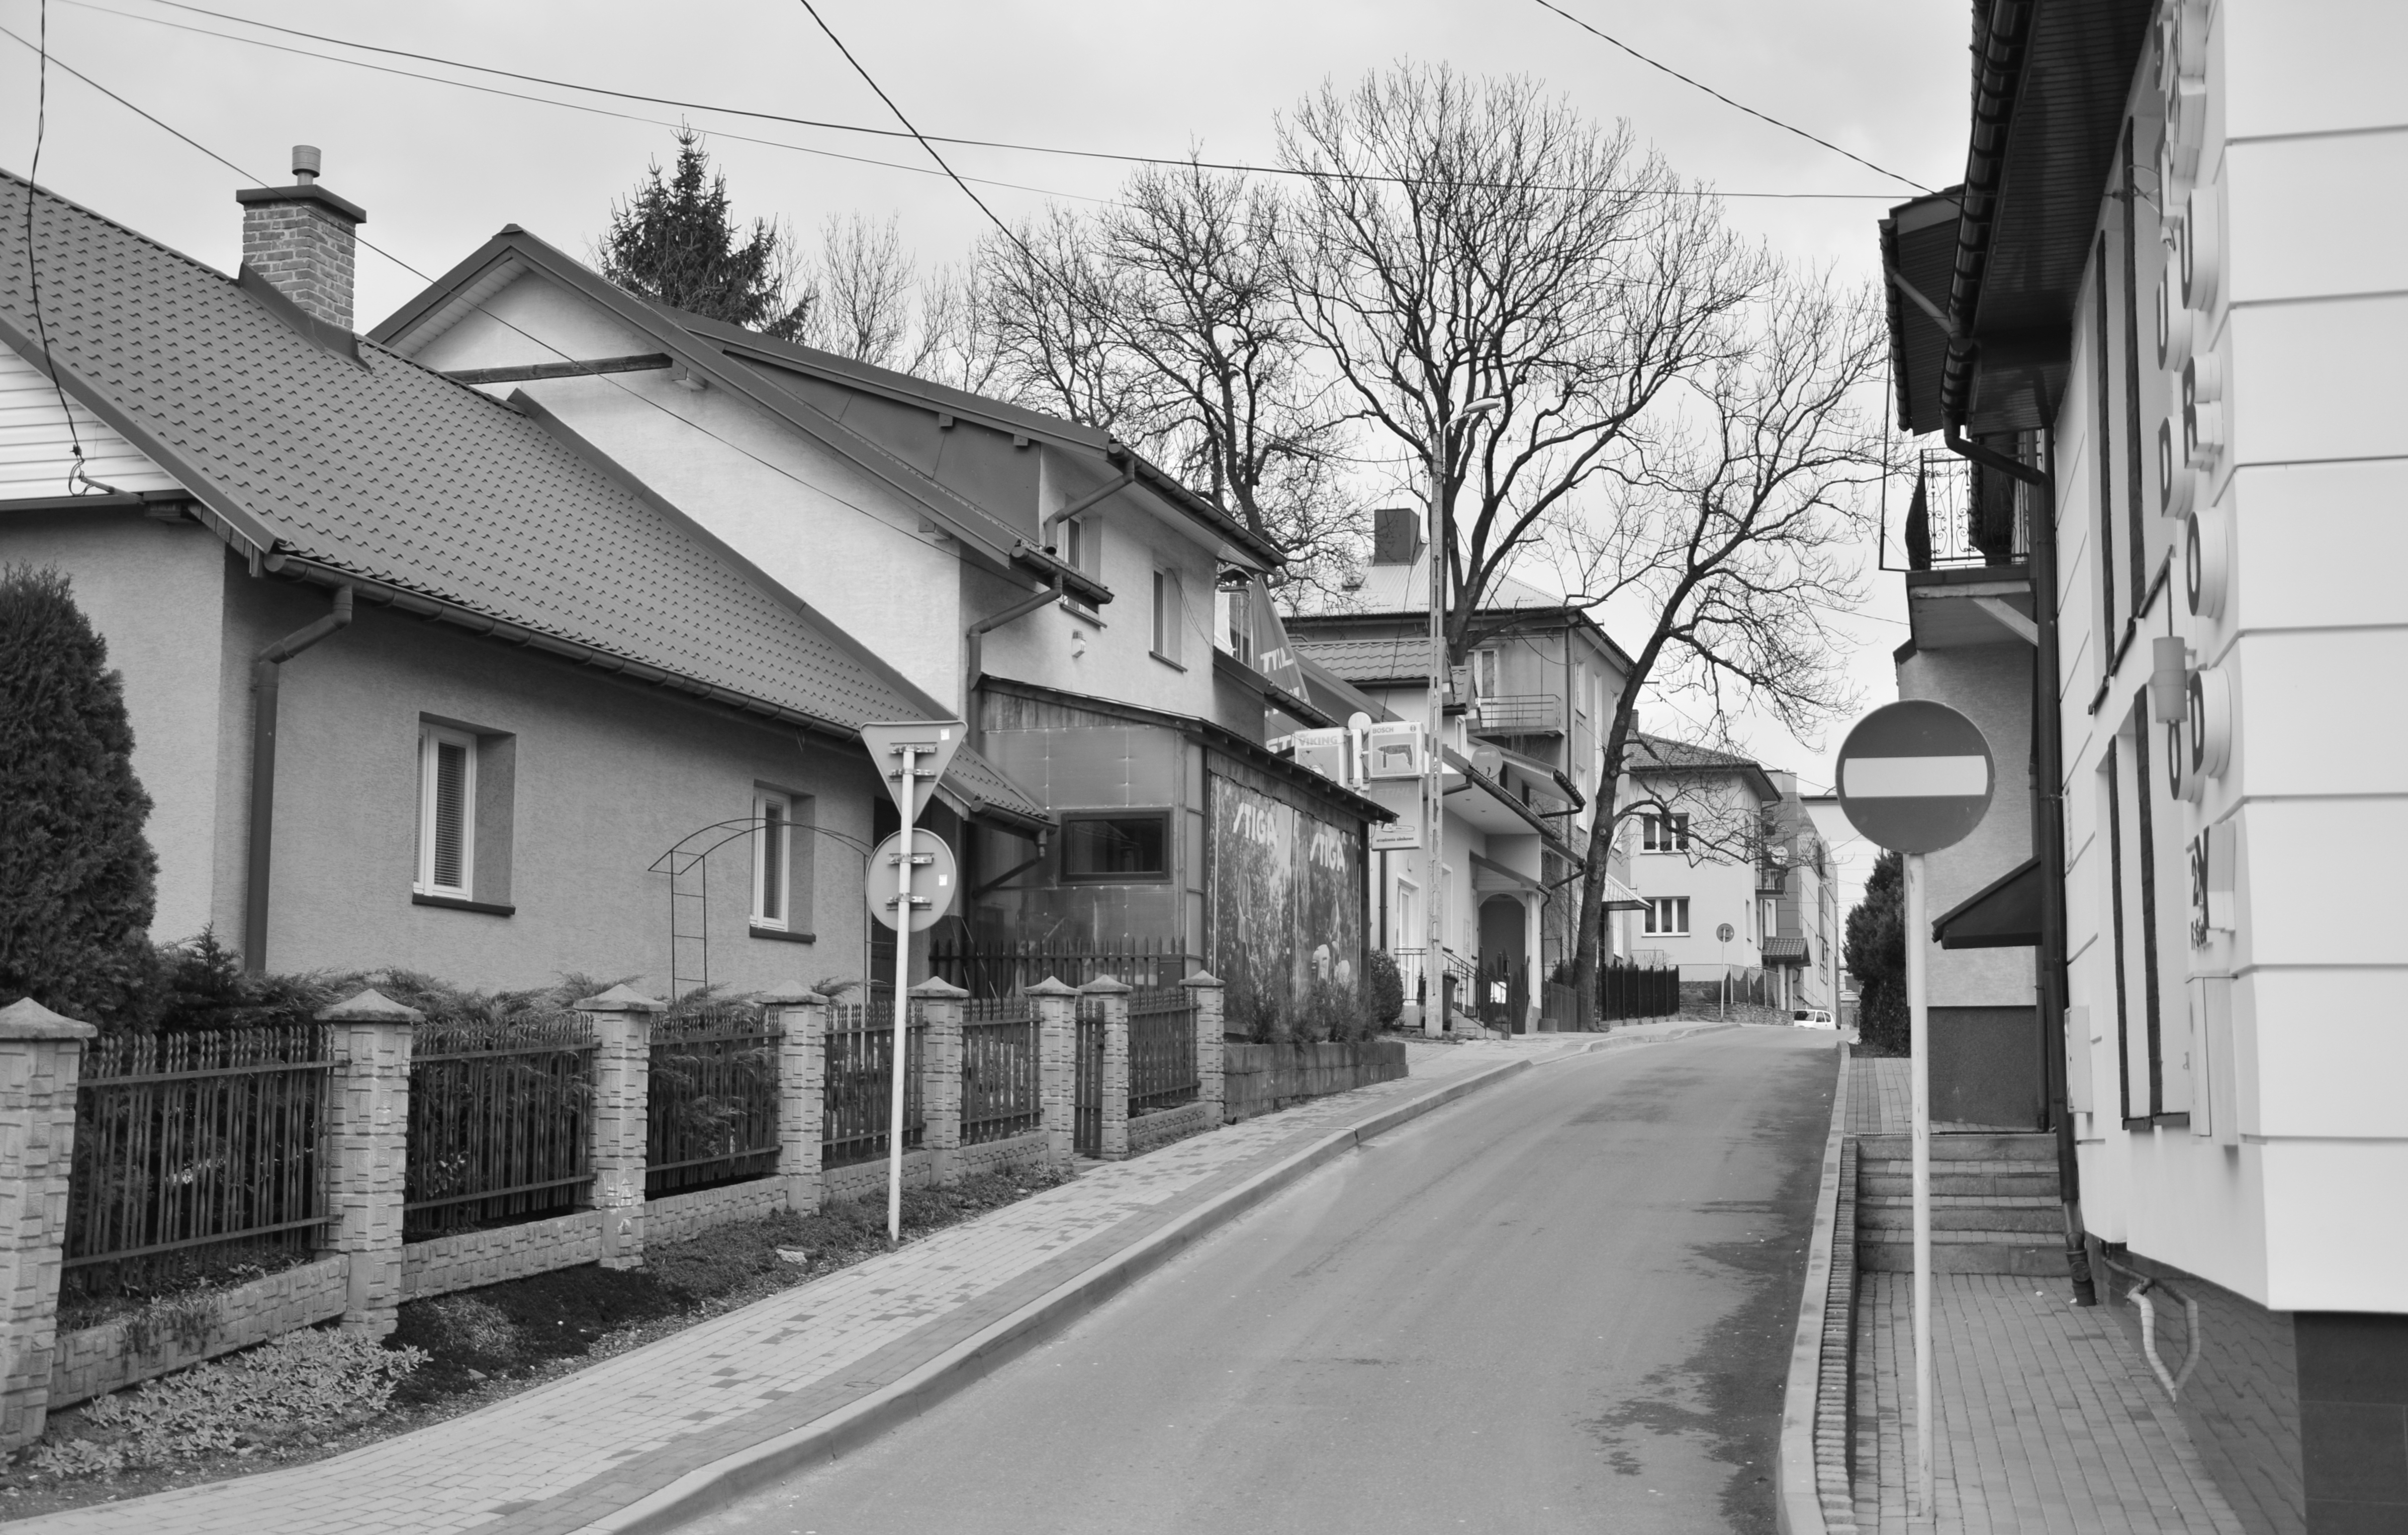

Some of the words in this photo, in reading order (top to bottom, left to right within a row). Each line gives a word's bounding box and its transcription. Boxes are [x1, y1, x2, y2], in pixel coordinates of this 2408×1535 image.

[2179, 190, 2216, 930] URODY
[1299, 736, 1338, 746] VIKING
[1233, 802, 1277, 848] STIGA
[1310, 832, 1345, 873] STIGA
